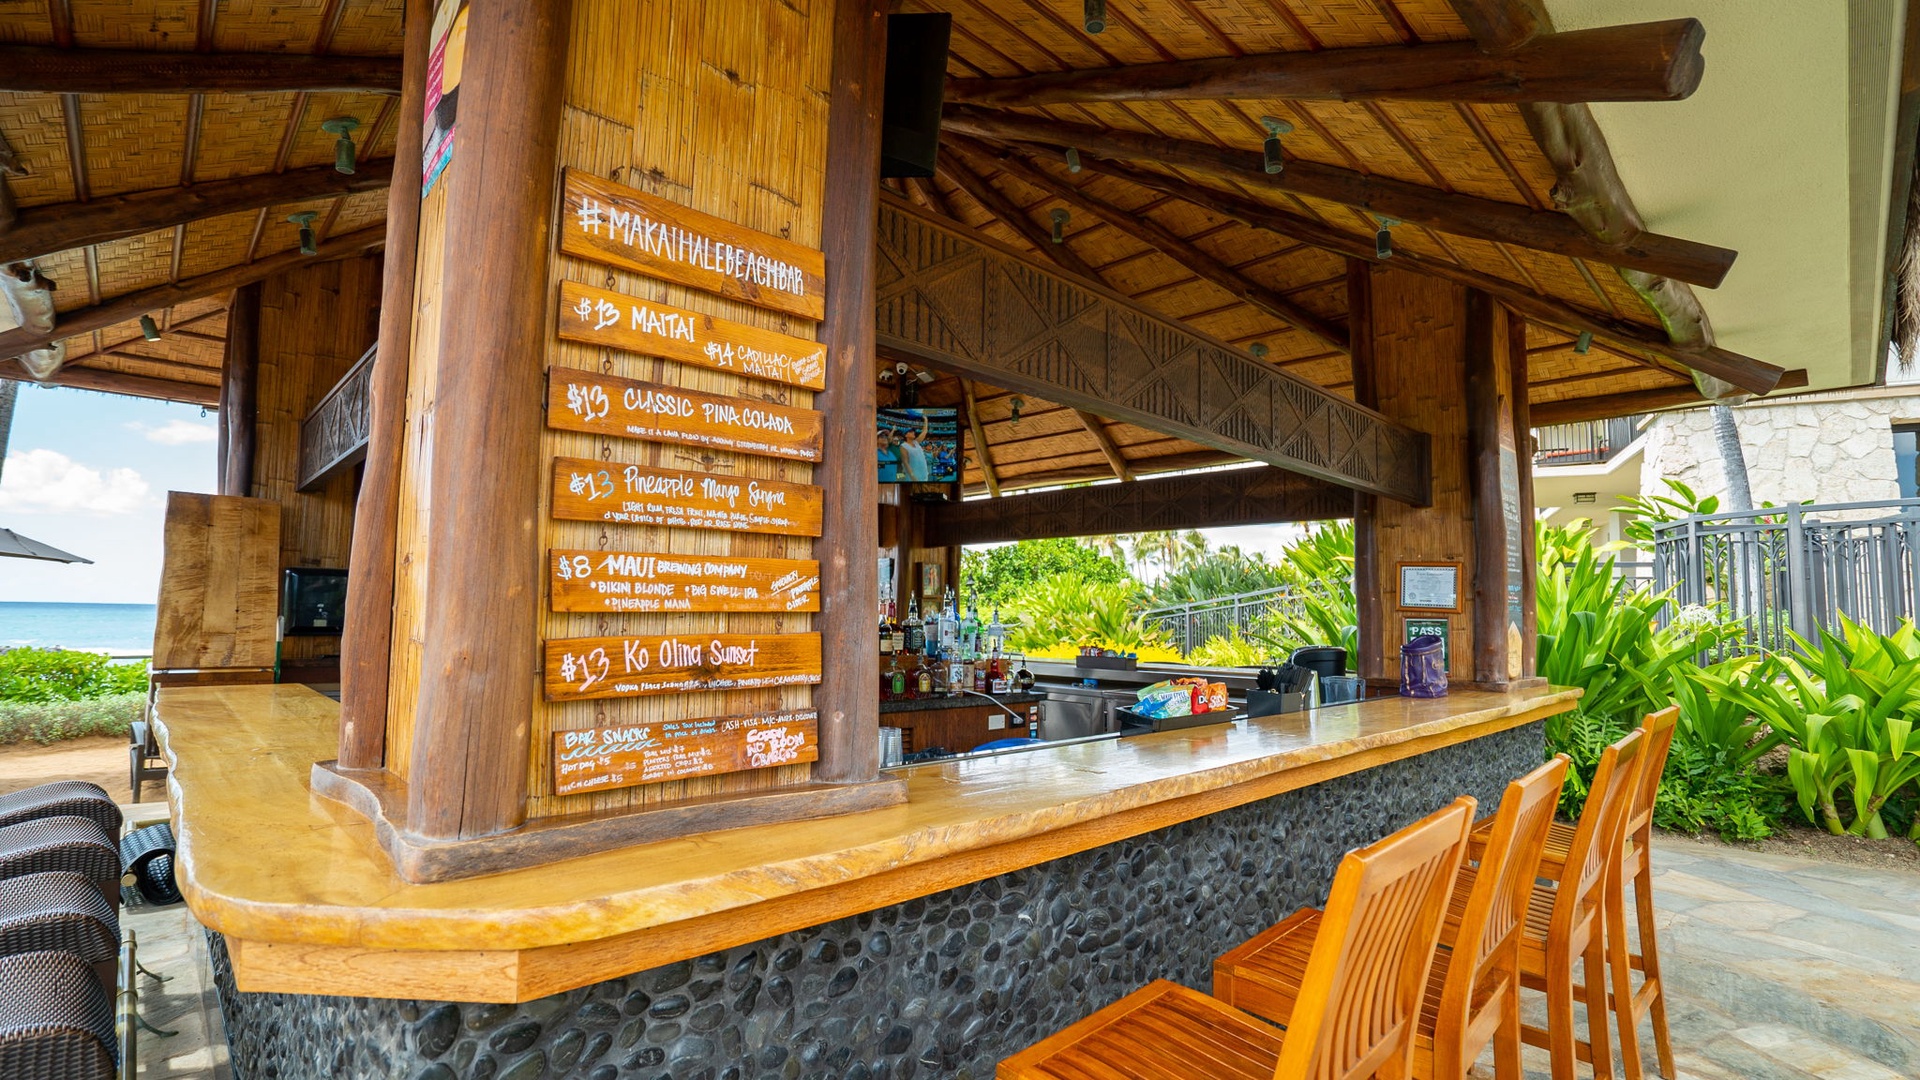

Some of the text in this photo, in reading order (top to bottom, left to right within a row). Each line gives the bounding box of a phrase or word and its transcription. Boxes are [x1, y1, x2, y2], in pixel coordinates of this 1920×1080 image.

[574, 297, 621, 331] $13
[704, 341, 734, 366] $14
[738, 345, 789, 368] CADILLAC
[567, 383, 794, 434] $13 CLASSIC PINA COLADA
[663, 430, 679, 438] LAVA
[681, 432, 699, 440] FLOW
[701, 435, 710, 444] BY
[570, 470, 615, 501] $13
[624, 465, 694, 499] Pineapple
[700, 477, 740, 507] Mango
[557, 555, 592, 580] $8
[596, 554, 656, 578] MAUI
[656, 559, 702, 575] BREWING
[704, 561, 748, 578] COMPANY
[597, 581, 630, 594] BIKINI
[634, 581, 674, 596] BLONDE
[691, 584, 707, 596] BIG
[709, 584, 740, 598] SWELL
[743, 587, 759, 599] IPA
[611, 597, 691, 611] PINEAPPLE MANA
[1411, 626, 1442, 636] PASS
[561, 638, 759, 692] $13 Ko Olina Sunset
[615, 684, 638, 692] VODKA
[641, 682, 660, 691] PEACH
[1173, 690, 1187, 700] STYLE
[722, 720, 739, 732] CASH
[743, 718, 758, 728] VISA
[564, 727, 650, 749] BAR SNACKS
[747, 726, 787, 743] SORRY
[746, 731, 805, 757] NO ROOM
[561, 756, 611, 774] HOT DOG $5
[611, 773, 624, 784] $5
